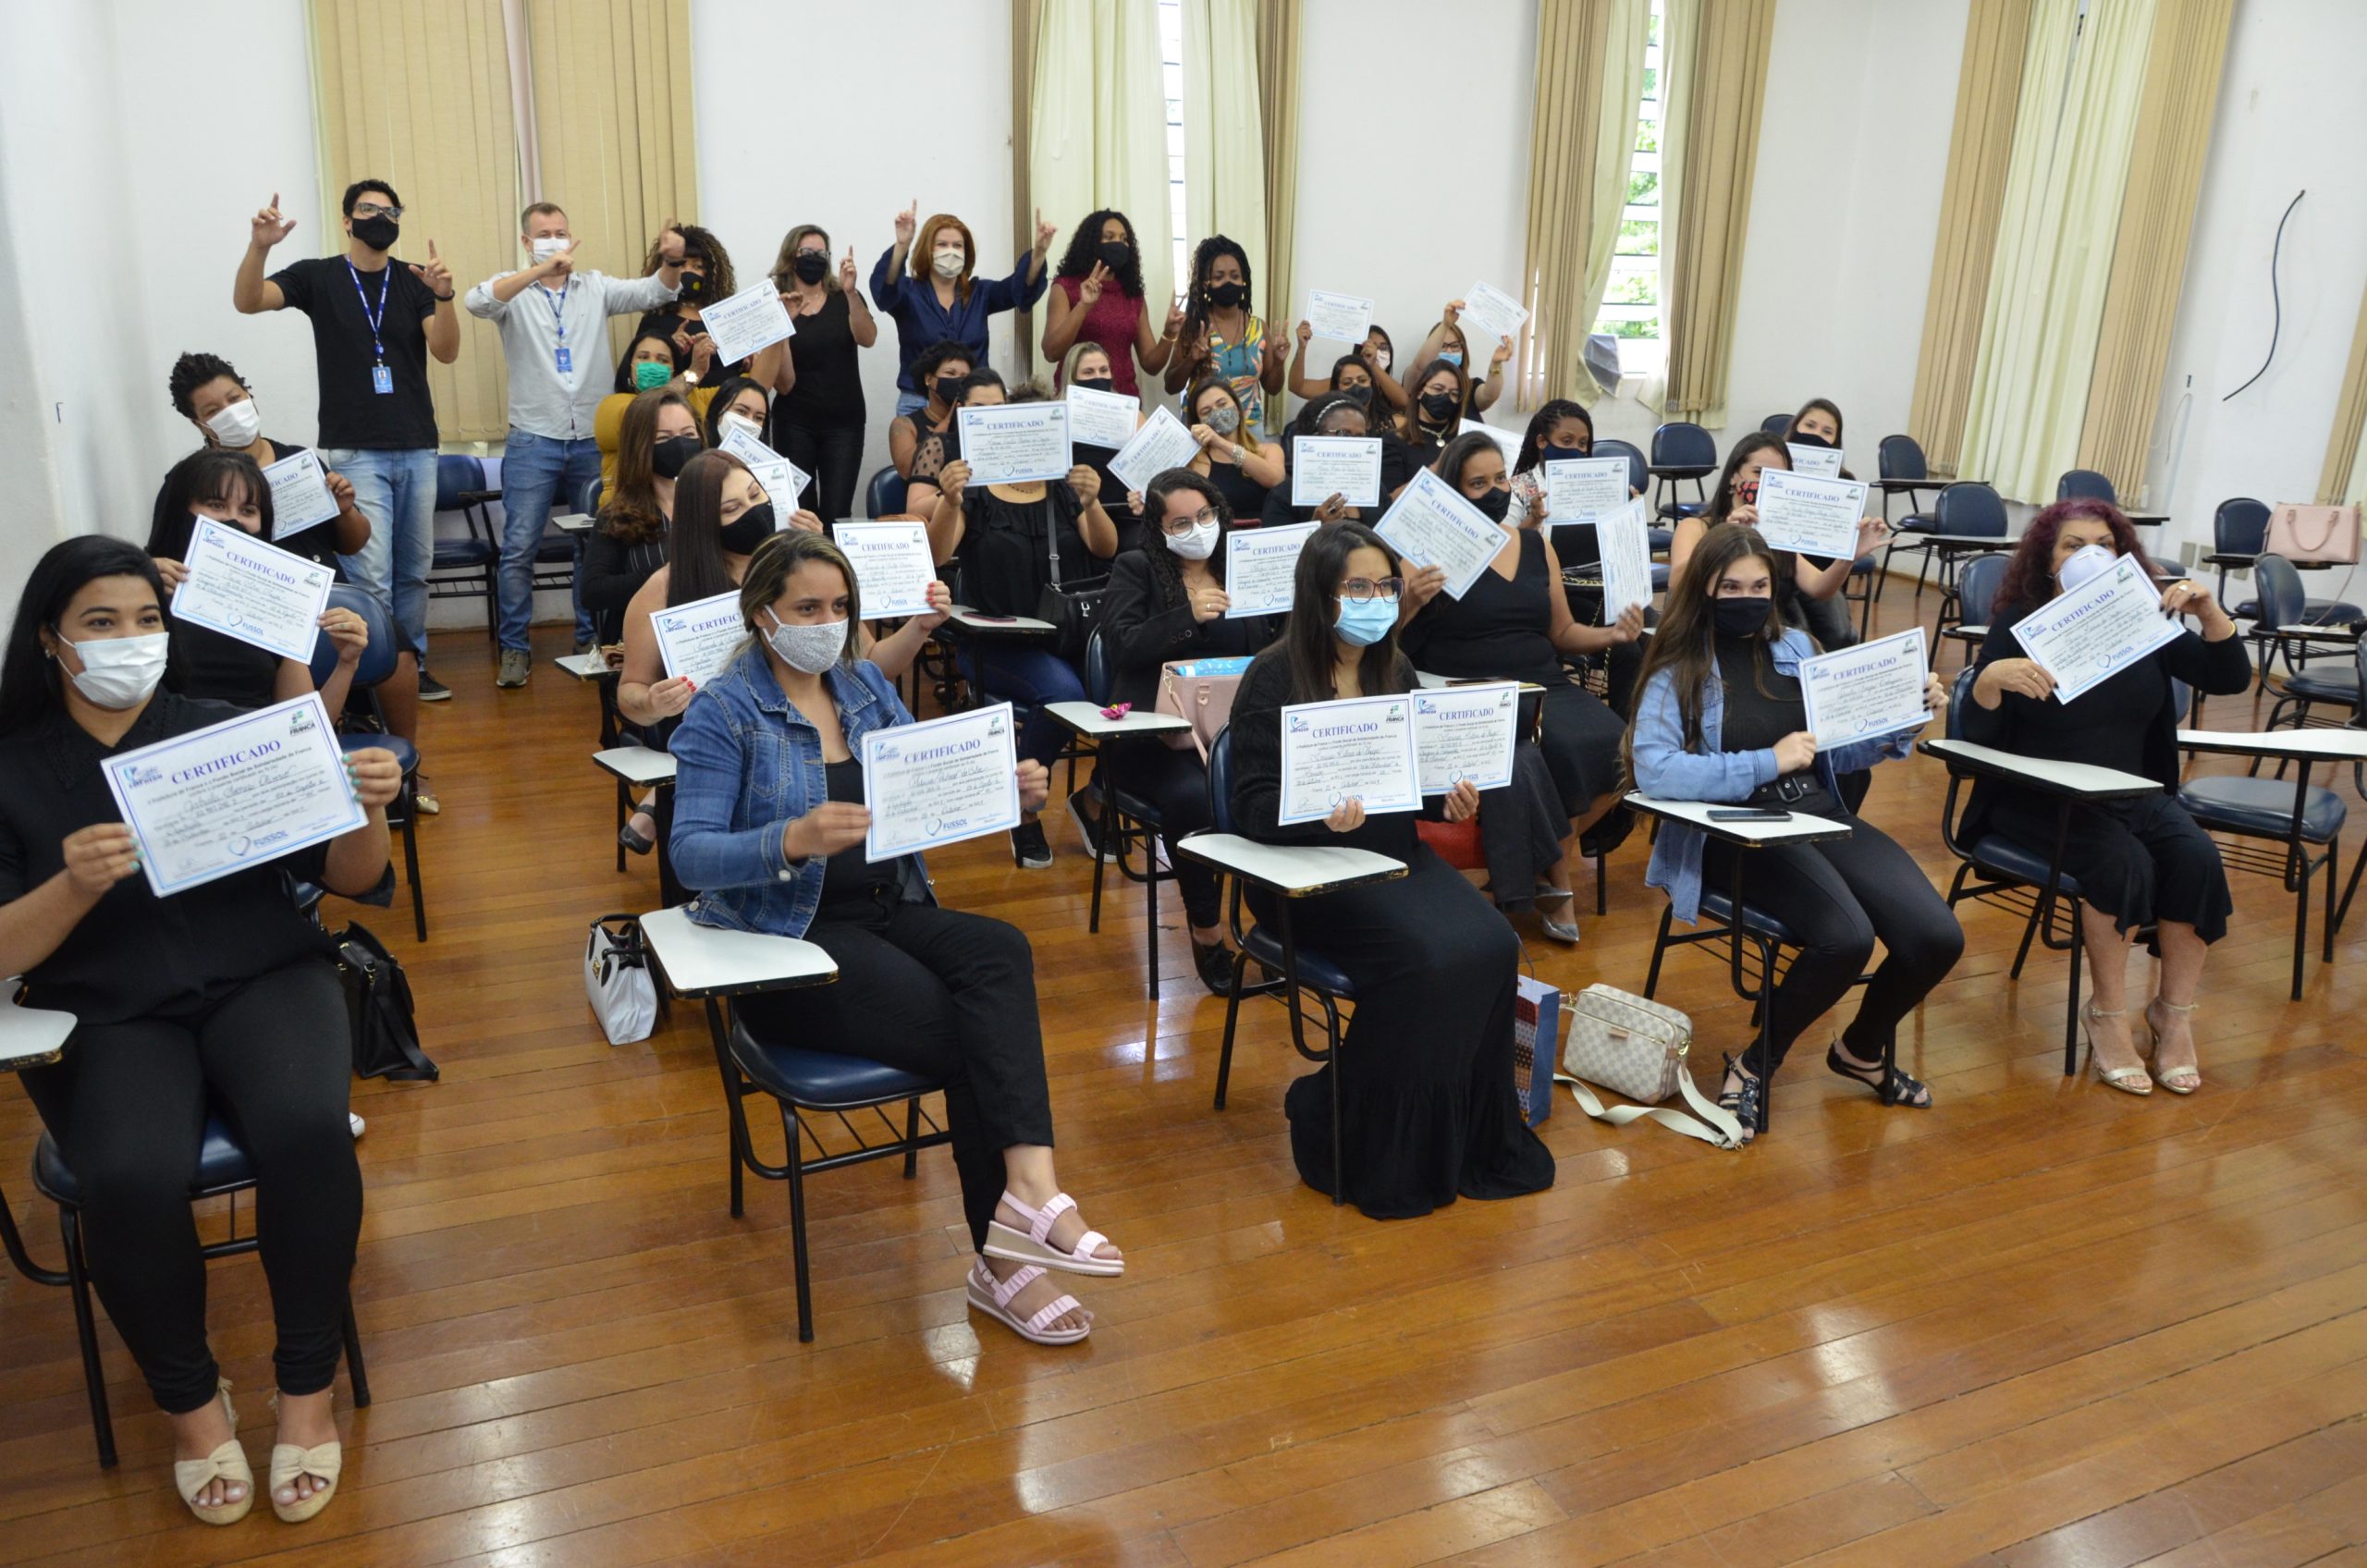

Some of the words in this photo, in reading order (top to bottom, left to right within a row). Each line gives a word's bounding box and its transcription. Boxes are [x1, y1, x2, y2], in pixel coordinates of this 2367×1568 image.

[987, 419, 1043, 430] CERTIFICADO
[1784, 488, 1840, 502] CERTIFICADO
[1430, 497, 1479, 540] CERTIFICADO
[861, 542, 909, 551] CERTIFICADO
[1252, 543, 1300, 555] CERTIFICADO
[226, 550, 296, 585] CERTIFICADO
[2050, 587, 2116, 632] CERTIFICADO
[241, 621, 264, 635] FUSSOL
[691, 612, 741, 633] CERTIFIC
[2111, 644, 2133, 660] FUSSOL
[1833, 655, 1896, 680] CERTIFICADO
[1440, 707, 1493, 720] CERTIFICADO
[288, 721, 316, 736] FRANCA
[1868, 716, 1888, 727] FUSSOL
[1312, 722, 1378, 738] CERTIFICADO
[904, 737, 980, 765] CERTIFICADO
[169, 738, 282, 785] CERTIFICADO
[1342, 793, 1363, 802] FUSOL
[943, 817, 966, 830] FUSSOL
[252, 828, 288, 848] FUSSOL
